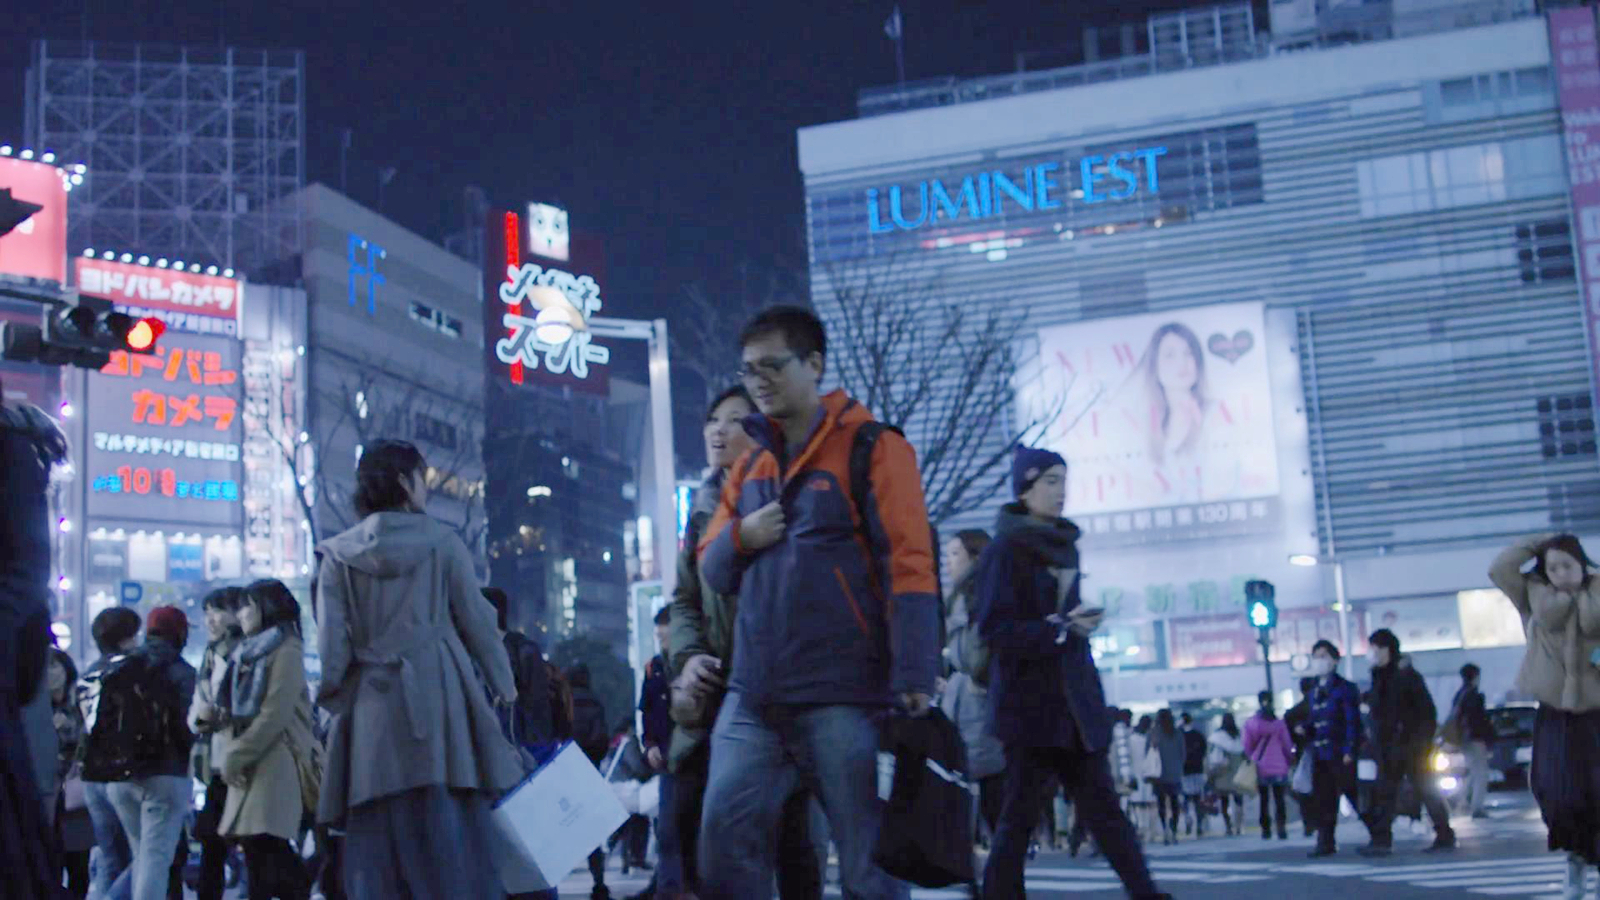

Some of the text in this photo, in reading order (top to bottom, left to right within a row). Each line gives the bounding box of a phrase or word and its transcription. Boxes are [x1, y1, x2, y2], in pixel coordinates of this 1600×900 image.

[866, 146, 1168, 234] LUMINE EST
[79, 267, 235, 311] ヨドバシカメラ
[132, 388, 238, 431] カメラ
